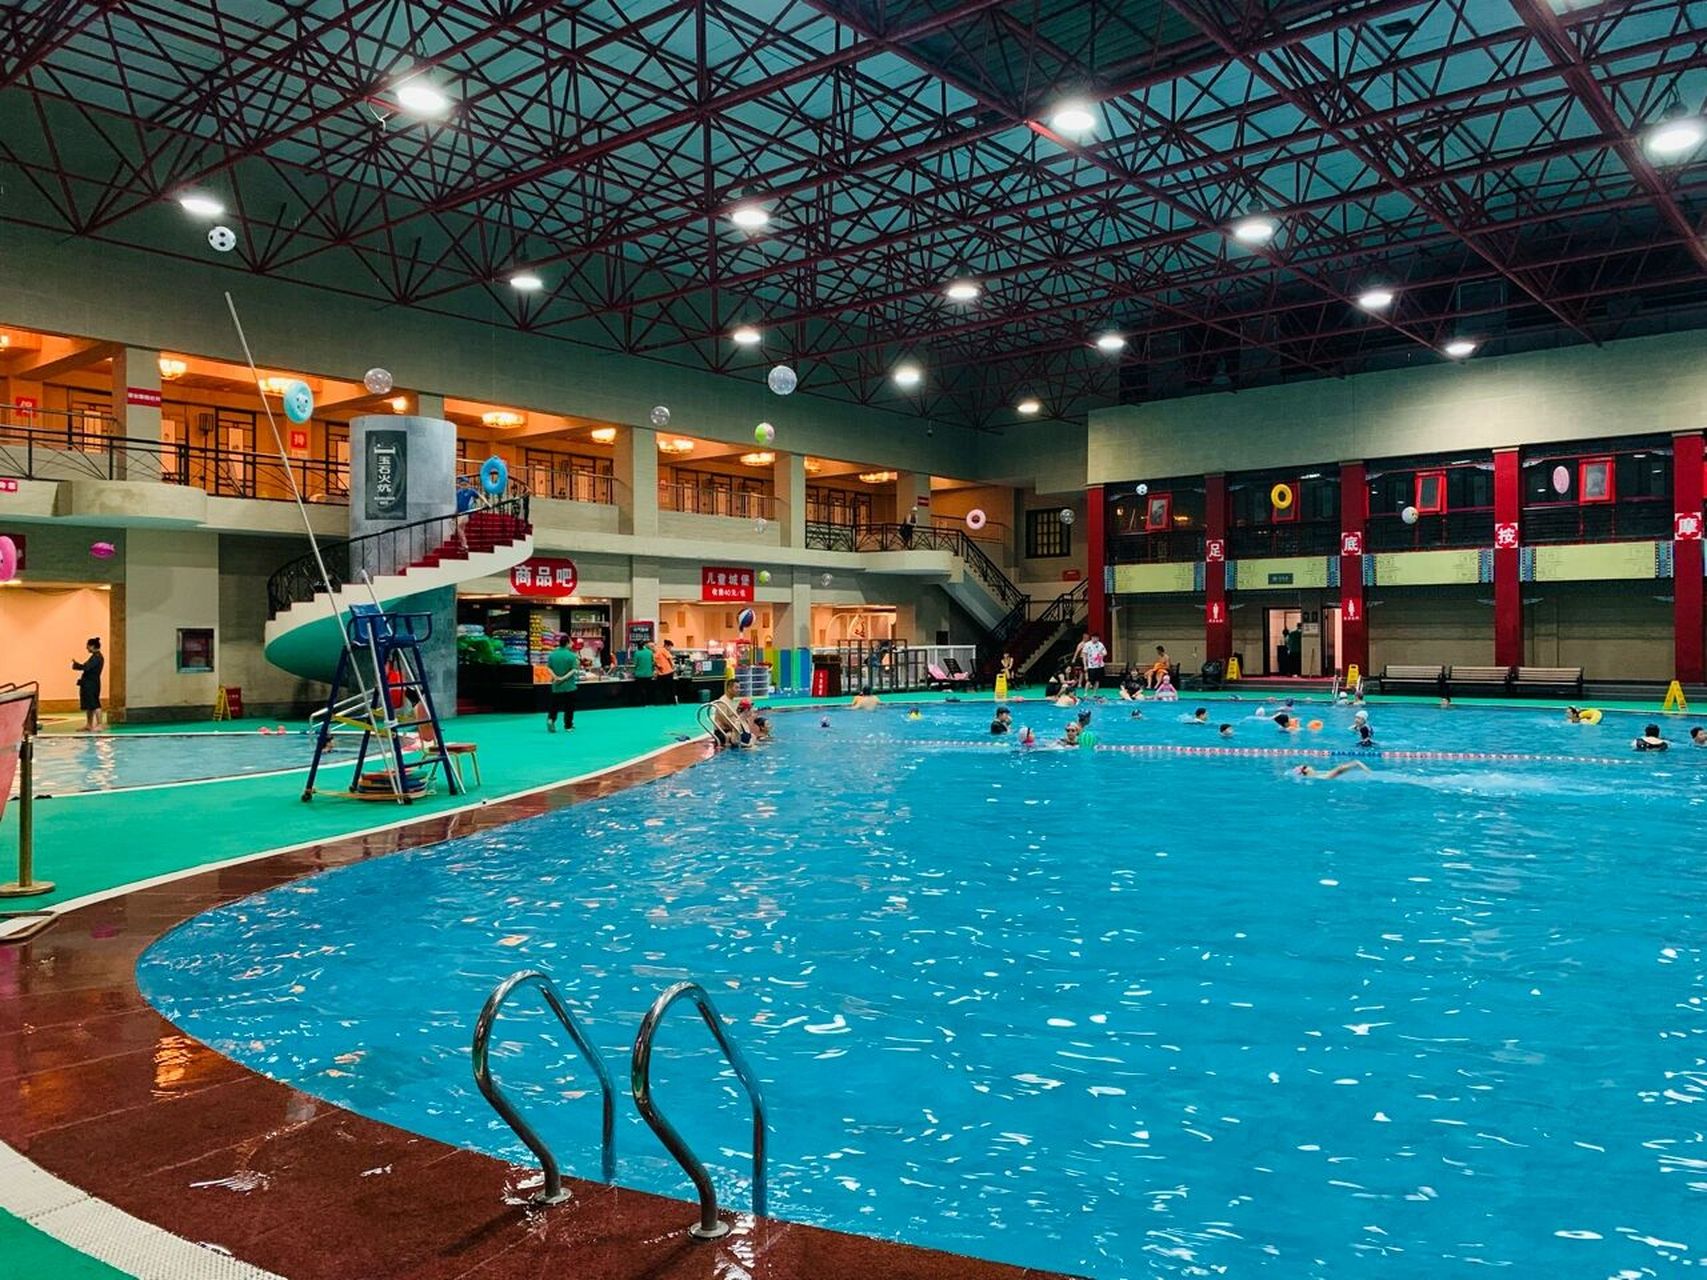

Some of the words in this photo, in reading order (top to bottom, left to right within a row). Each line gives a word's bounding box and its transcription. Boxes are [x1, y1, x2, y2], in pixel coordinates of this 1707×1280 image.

[1343, 536, 1359, 552] 底
[1497, 527, 1516, 545] 按
[514, 565, 574, 587] 商品吧
